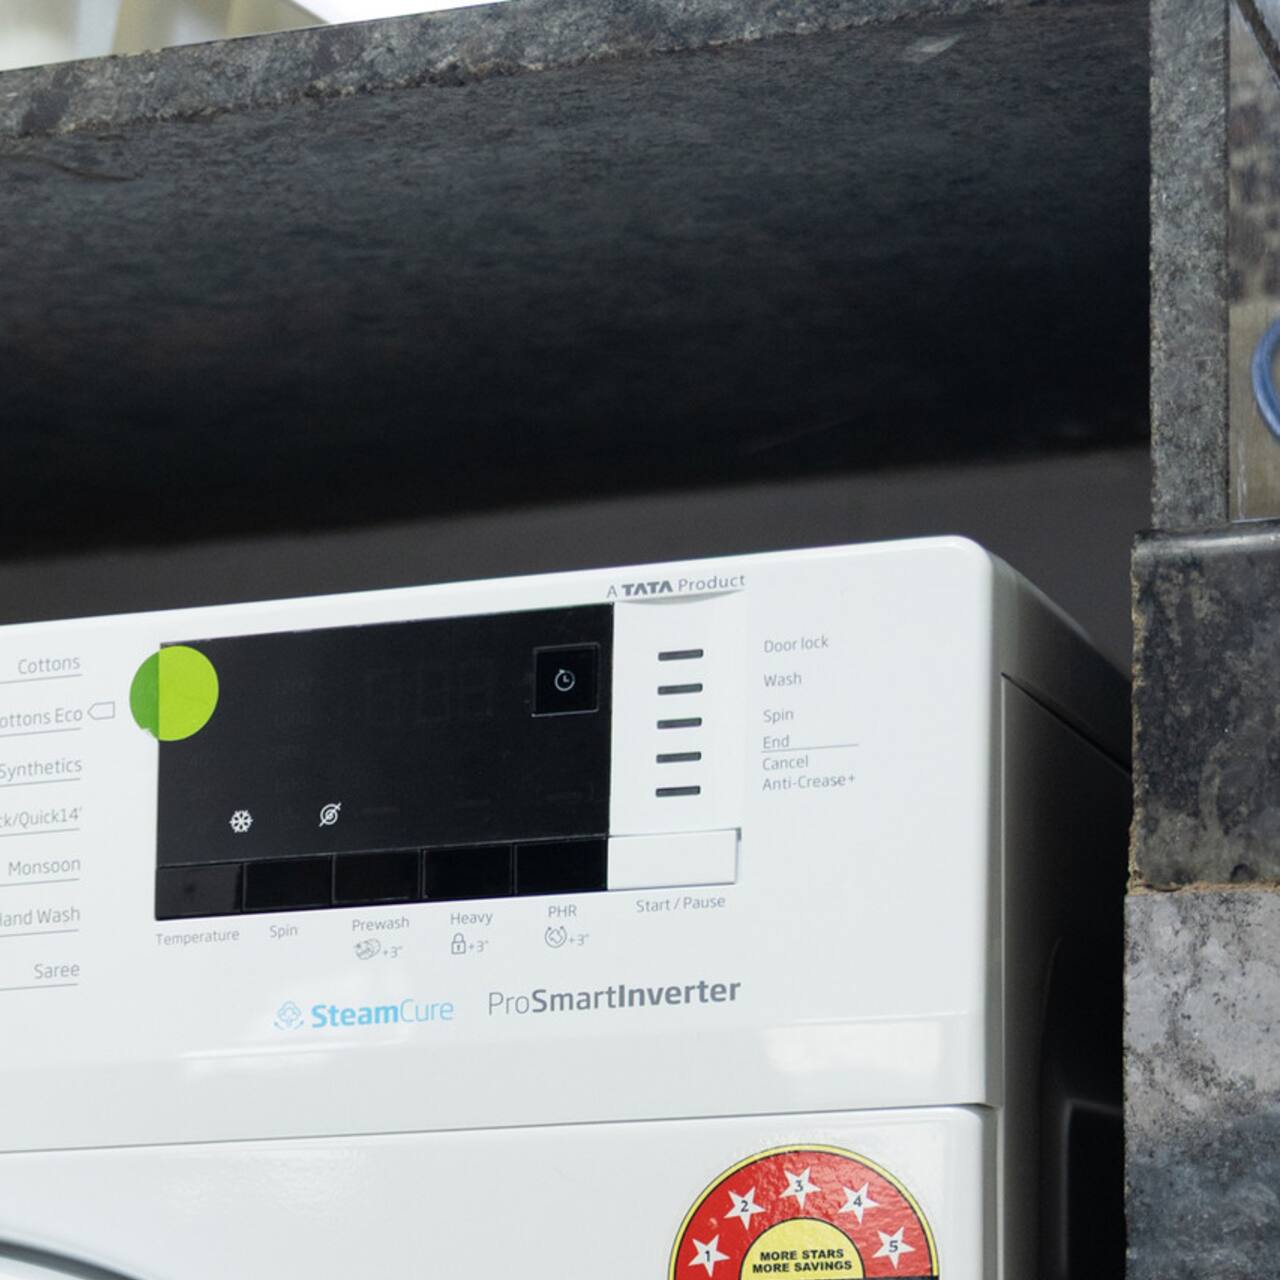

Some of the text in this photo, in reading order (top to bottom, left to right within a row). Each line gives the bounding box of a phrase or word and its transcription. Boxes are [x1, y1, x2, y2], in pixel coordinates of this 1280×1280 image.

[606, 575, 745, 598] A TATA Product
[763, 635, 829, 653] Door lock
[18, 655, 80, 675] Cottons
[763, 672, 802, 687] Wash
[55, 707, 83, 725] Eco
[763, 709, 794, 724] Spin
[763, 734, 790, 749] End
[762, 755, 809, 771] Cancel
[762, 775, 855, 791] Anti-Crease+
[8, 859, 81, 876] Monsoon
[548, 905, 577, 918] PHR
[636, 899, 671, 913] Start
[683, 895, 726, 910] Pause
[36, 906, 81, 924] Wash
[450, 911, 493, 926] Heavy
[269, 924, 298, 940] Spin
[352, 916, 409, 932] Prewash
[156, 929, 240, 947] Temperature
[34, 963, 80, 980] Saree
[488, 980, 741, 1016] ProSmartInverter
[311, 998, 454, 1028] SteamCure
[795, 1179, 804, 1193] 3
[740, 1200, 750, 1212] 2
[853, 1195, 863, 1207] 4
[888, 1240, 899, 1253] 5
[760, 1249, 844, 1261] MORE STARS
[752, 1260, 852, 1274] MORE SAVINGS
